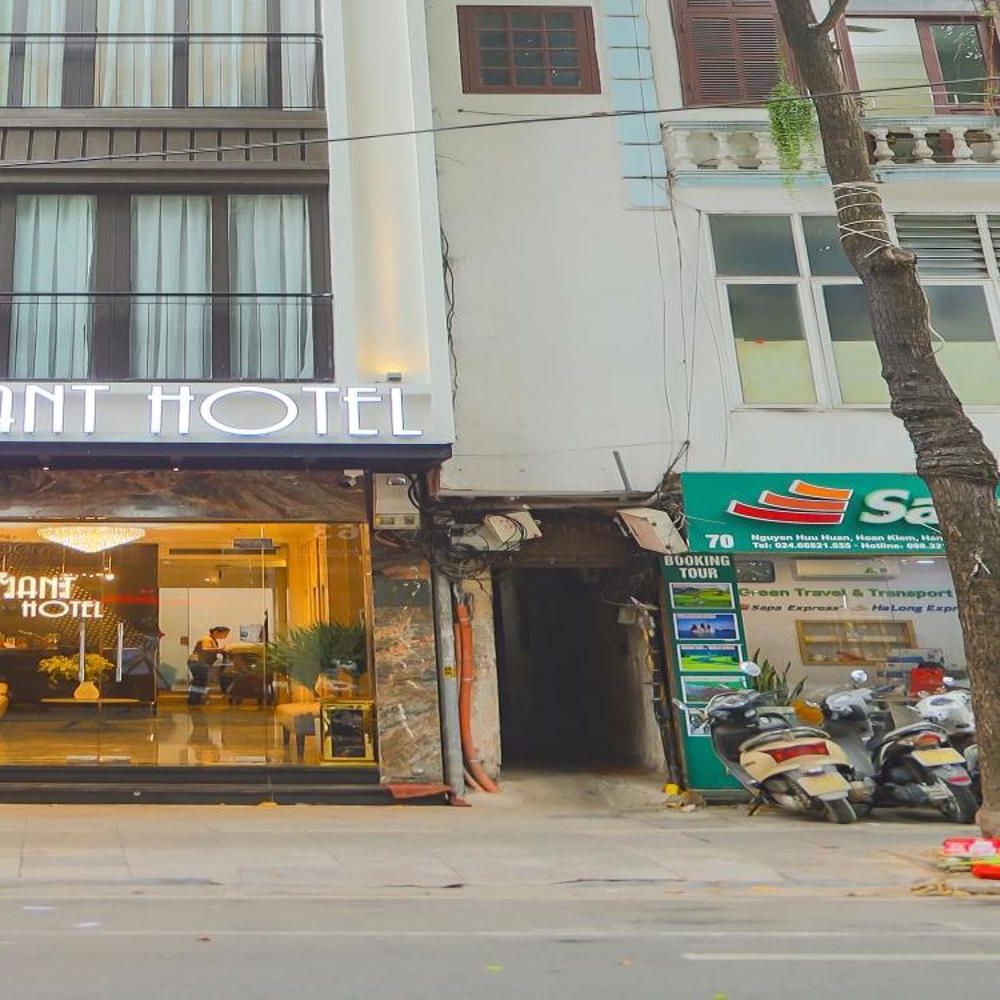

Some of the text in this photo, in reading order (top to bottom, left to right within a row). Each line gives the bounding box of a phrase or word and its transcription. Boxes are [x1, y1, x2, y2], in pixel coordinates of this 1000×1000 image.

[147, 386, 423, 438] HOTEL
[859, 489, 940, 525] Sa
[705, 534, 735, 549] 70
[664, 555, 731, 567] BOOKING
[679, 567, 719, 579] TOUR
[867, 588, 954, 599] Transport
[21, 600, 104, 619] HOTEL
[926, 604, 958, 613] Expr
